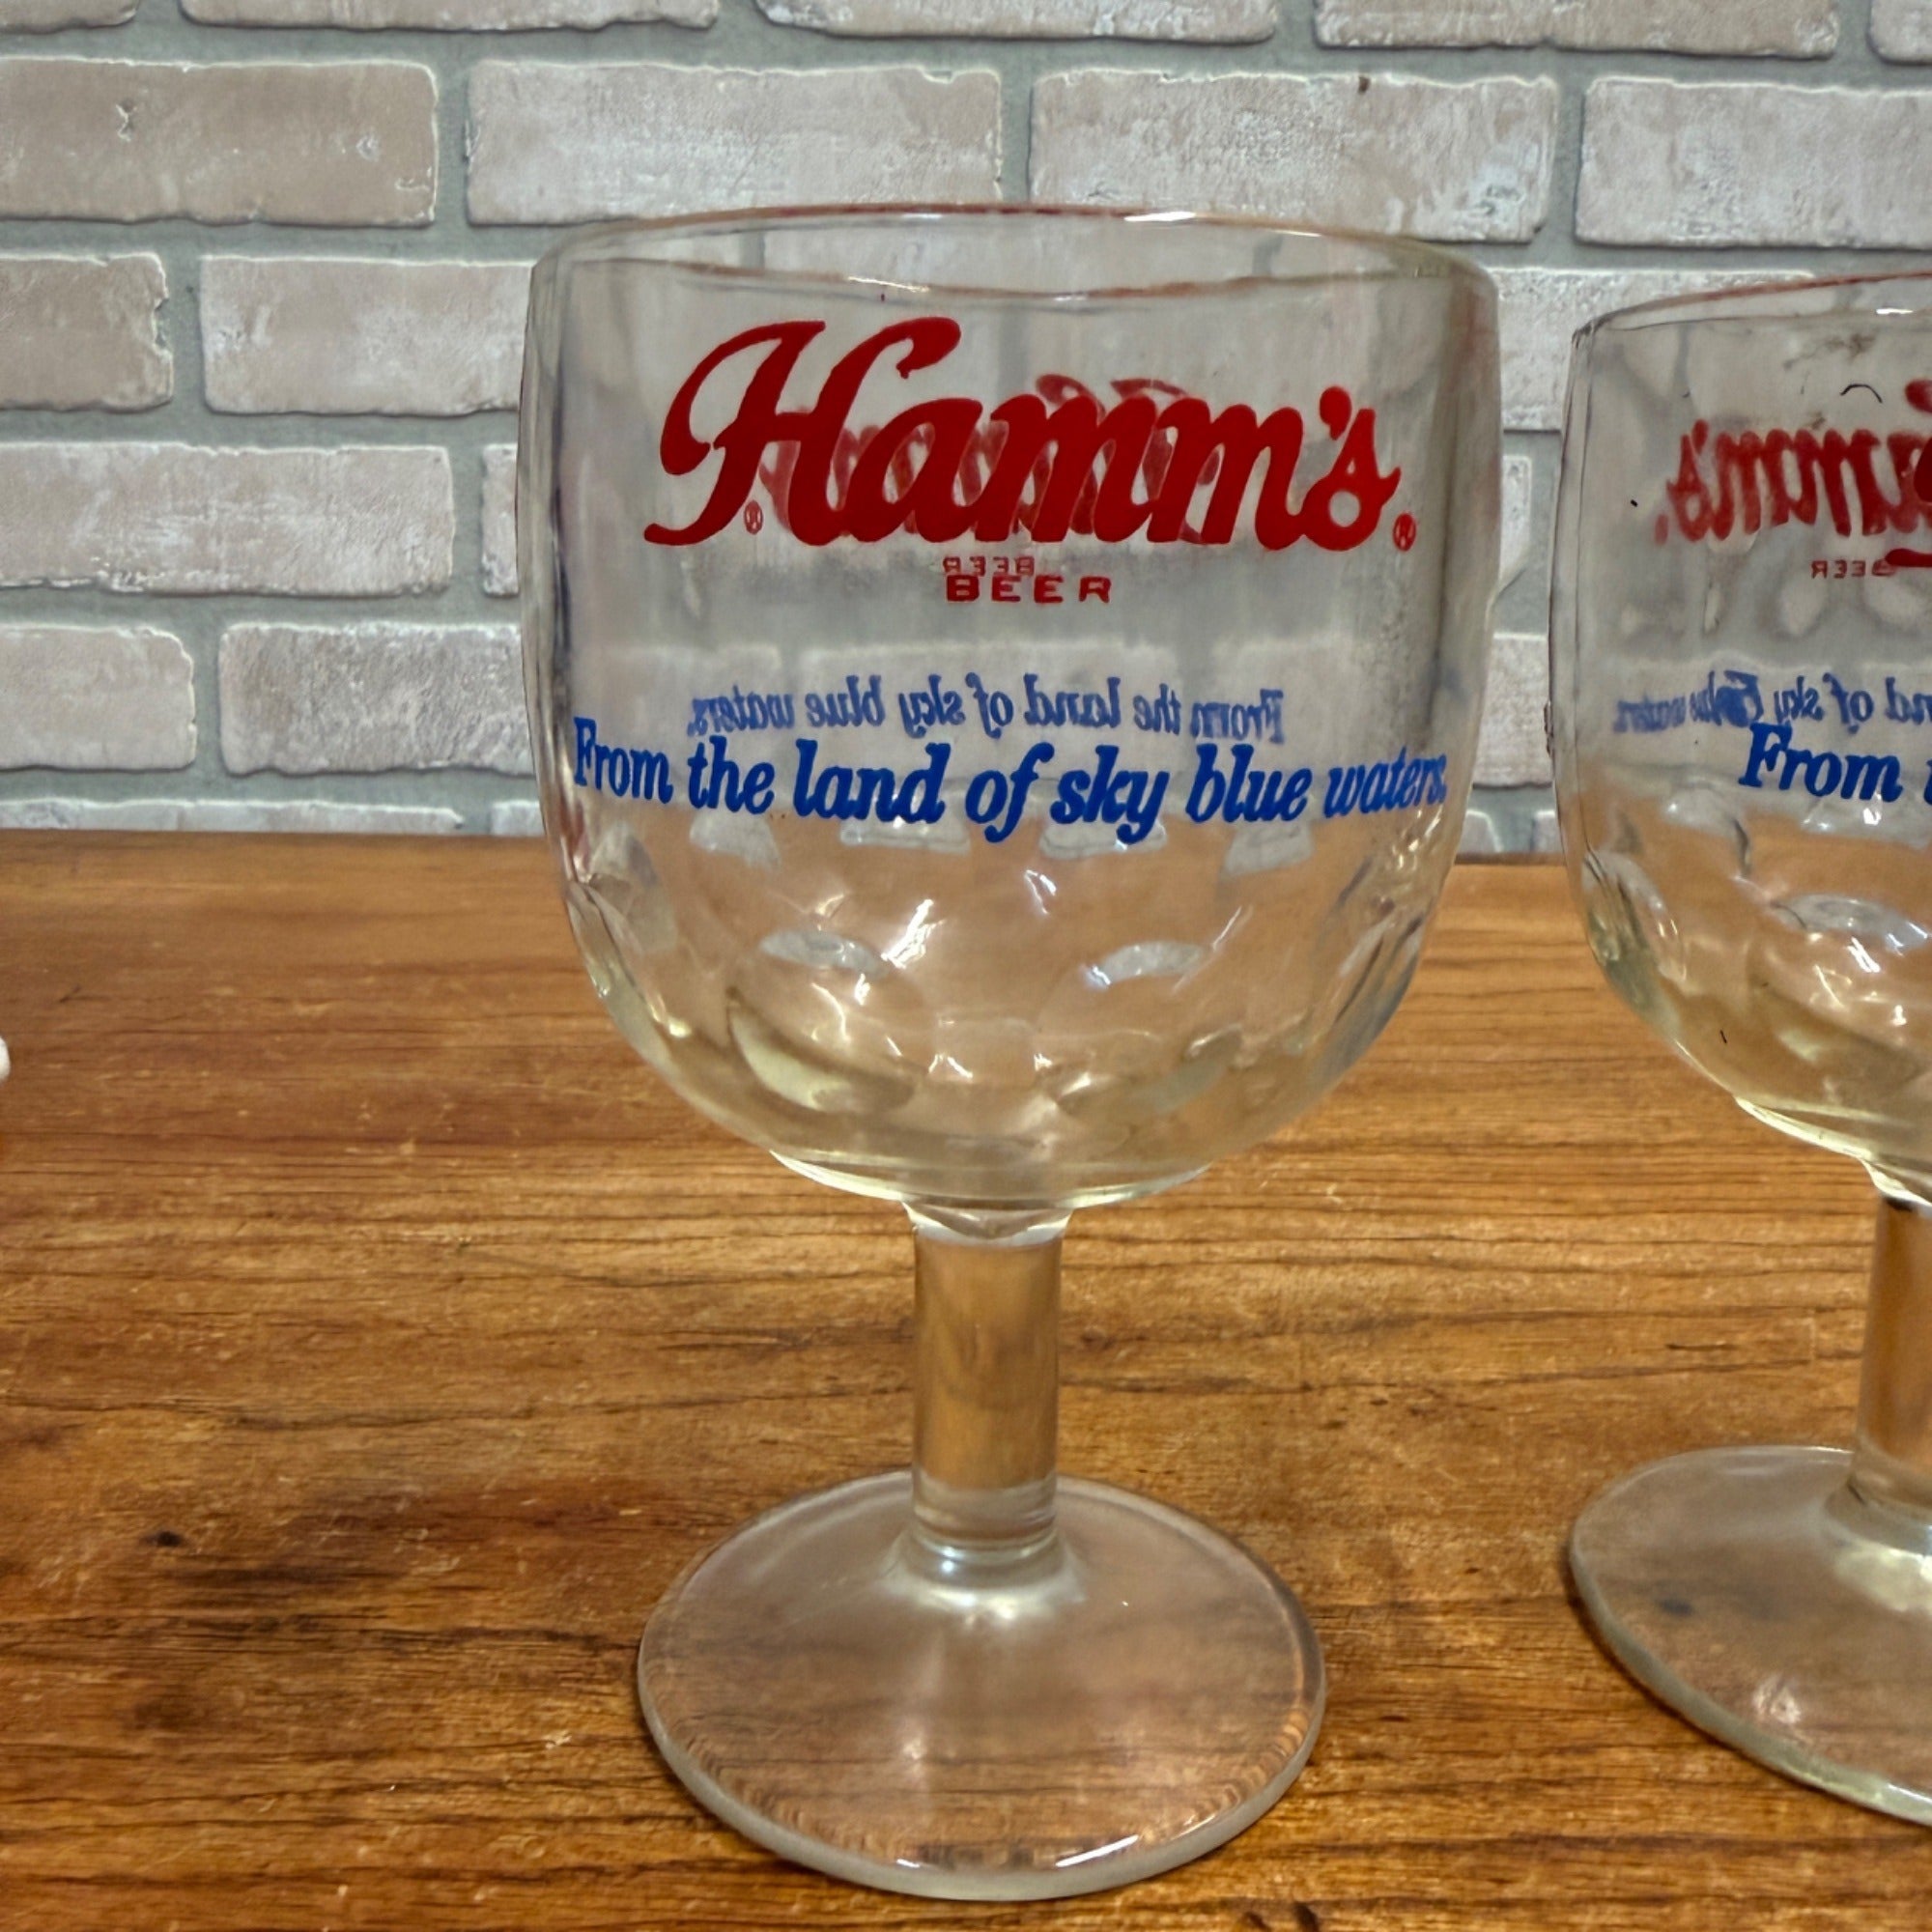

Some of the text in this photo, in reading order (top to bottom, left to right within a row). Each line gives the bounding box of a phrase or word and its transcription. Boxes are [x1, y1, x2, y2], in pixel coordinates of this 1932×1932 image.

[643, 316, 1403, 553] Hamm's
[946, 574, 1113, 605] BEER
[572, 716, 674, 805] From
[687, 734, 776, 815] the
[792, 737, 952, 824] land
[964, 741, 1055, 843] of
[1049, 744, 1170, 844] sky
[1184, 742, 1315, 824] blue
[1737, 720, 1905, 803] From
